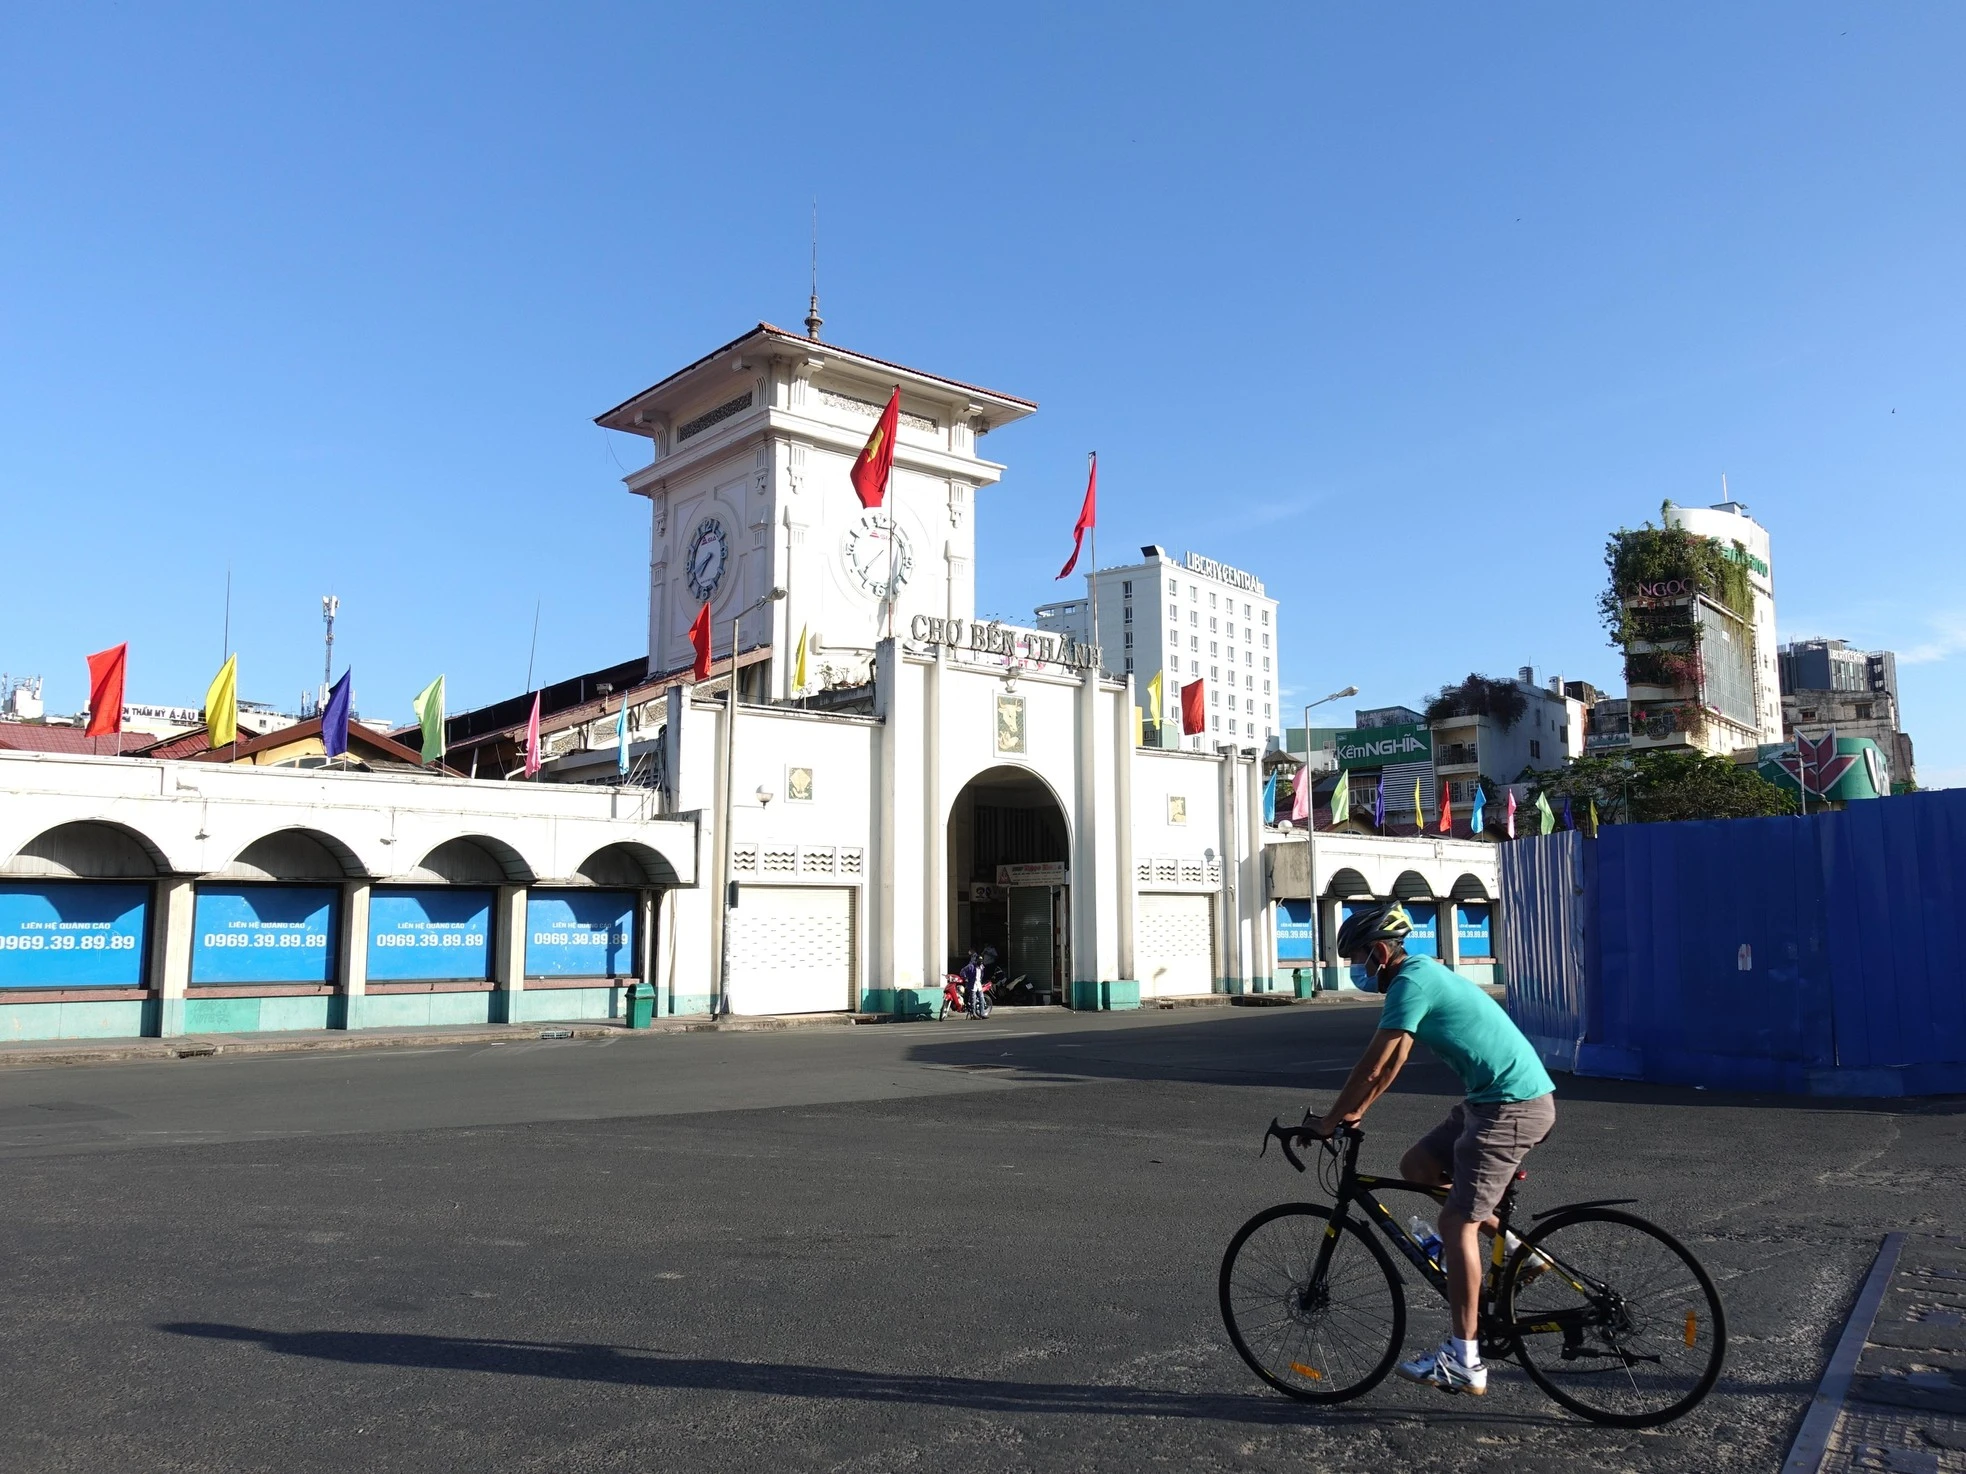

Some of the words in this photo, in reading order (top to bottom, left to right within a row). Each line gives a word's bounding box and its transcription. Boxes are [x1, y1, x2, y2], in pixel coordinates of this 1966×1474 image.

[1186, 551, 1222, 580] LIBERTY
[971, 619, 1017, 656] BẾN
[204, 933, 327, 948] 0969.39.89.89
[376, 934, 484, 947] 0969.39.89.89
[534, 932, 629, 946] 0969.39.89.89
